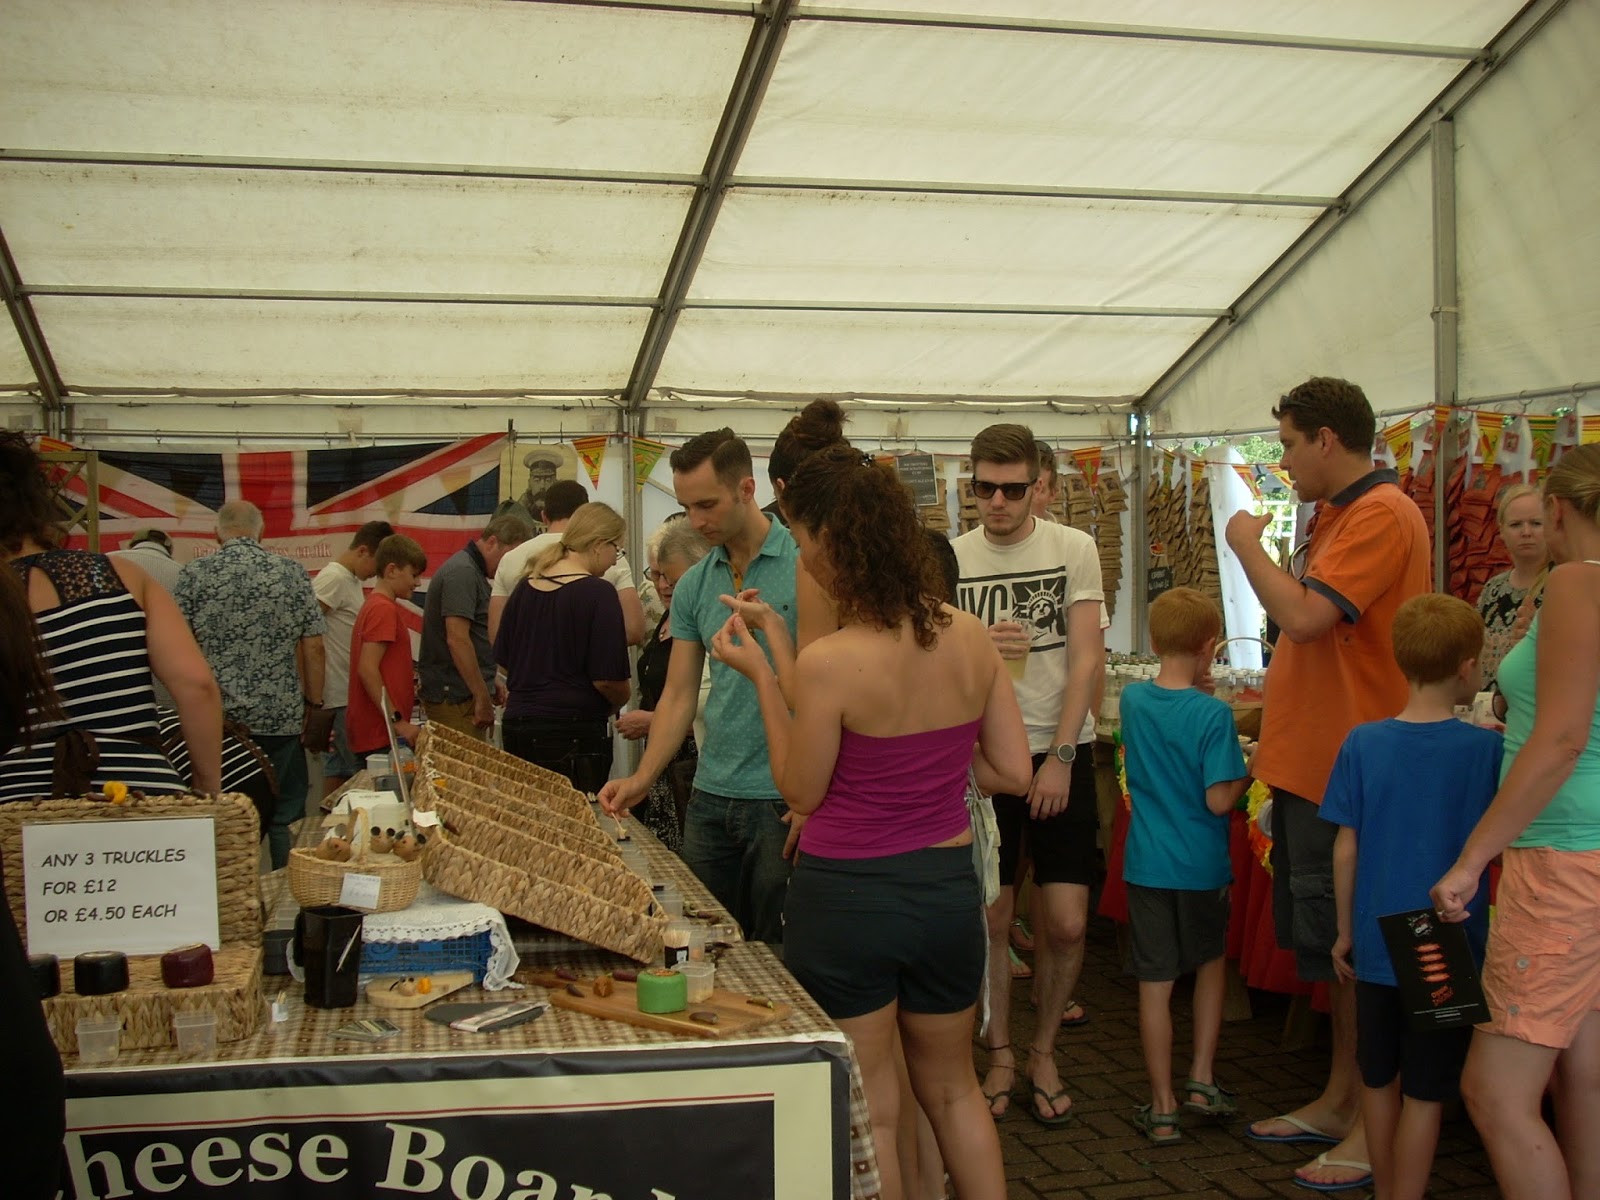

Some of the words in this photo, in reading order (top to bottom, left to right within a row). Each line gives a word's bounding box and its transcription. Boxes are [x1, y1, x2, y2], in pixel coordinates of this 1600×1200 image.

[41, 853, 78, 868] ANY
[85, 853, 94, 866] 3
[102, 849, 186, 865] TRUCKLES
[43, 881, 76, 896] FOR
[84, 879, 117, 894] £12
[44, 909, 68, 923] OR
[75, 906, 126, 922] £4.50
[132, 904, 177, 919] EACH
[54, 1131, 349, 1200] heese
[375, 1122, 676, 1200] Boa
